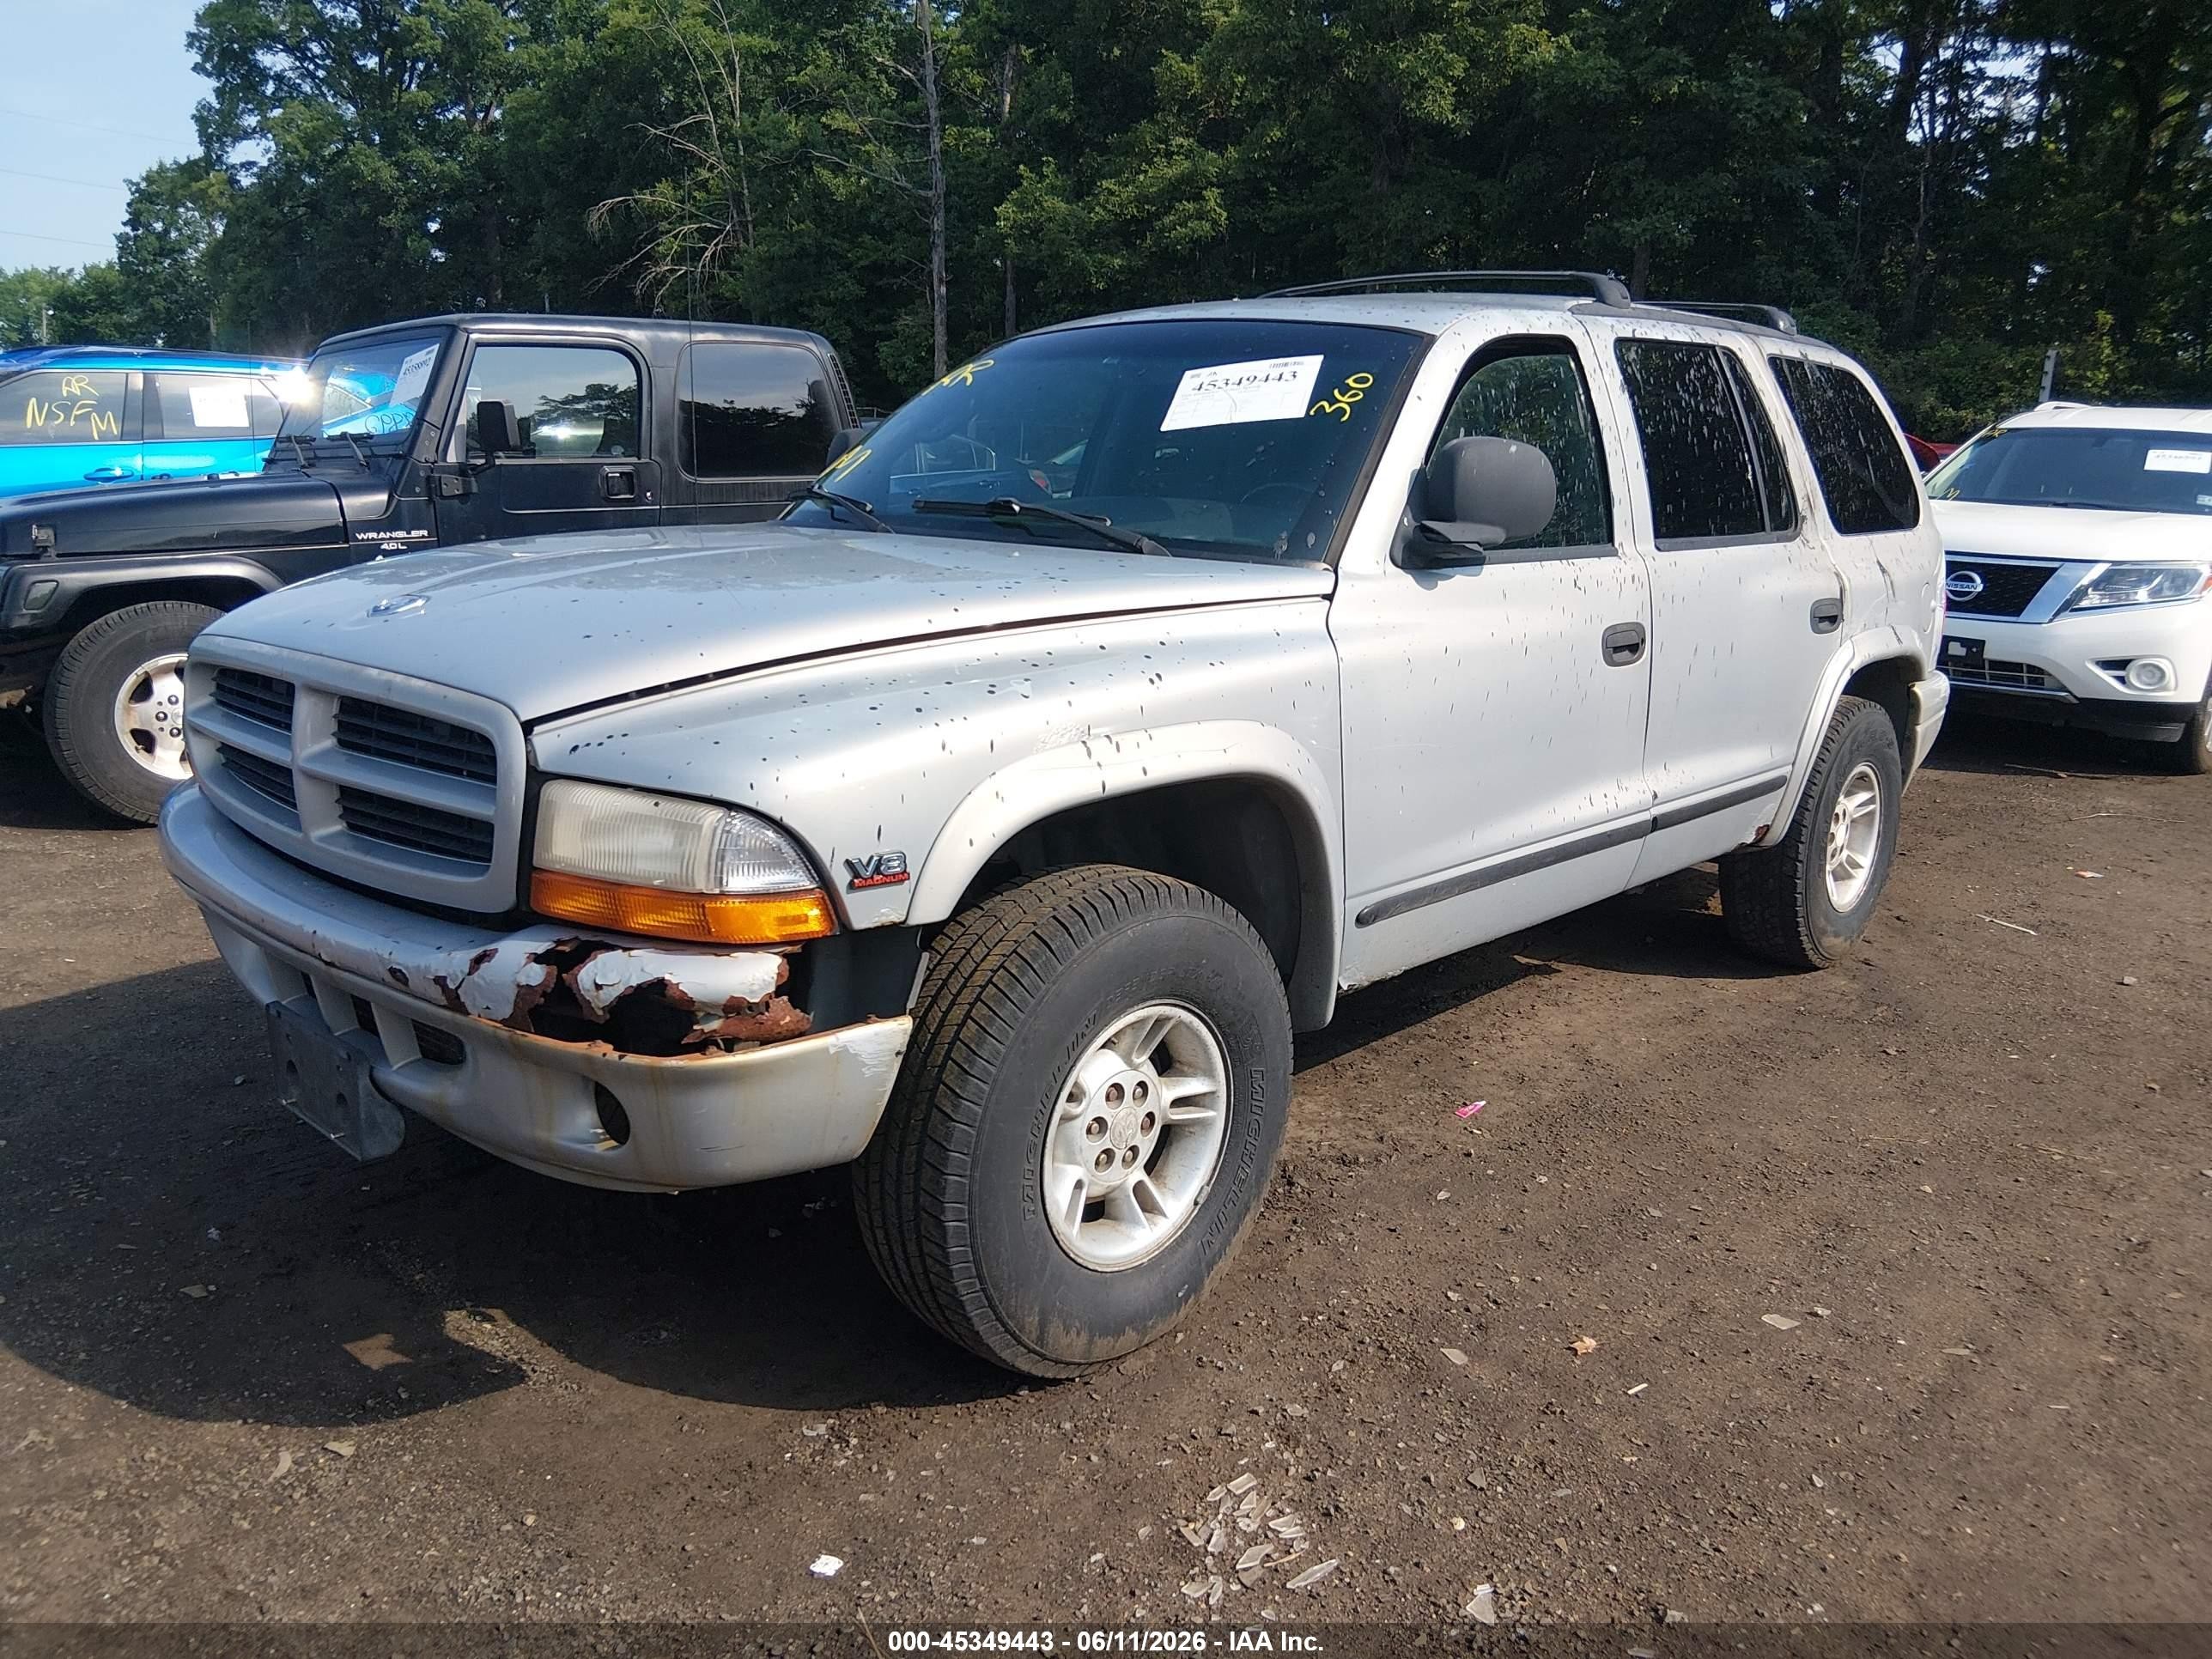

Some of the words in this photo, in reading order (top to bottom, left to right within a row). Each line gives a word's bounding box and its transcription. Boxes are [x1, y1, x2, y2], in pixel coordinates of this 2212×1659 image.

[62, 375, 100, 398] AR
[1192, 370, 1298, 392] 45349443
[1309, 372, 1374, 422] 360
[356, 530, 429, 540] WRANGLER
[843, 852, 907, 878] V8
[854, 872, 909, 887] MAGNUM
[1200, 1067, 1266, 1257] MICHELIN
